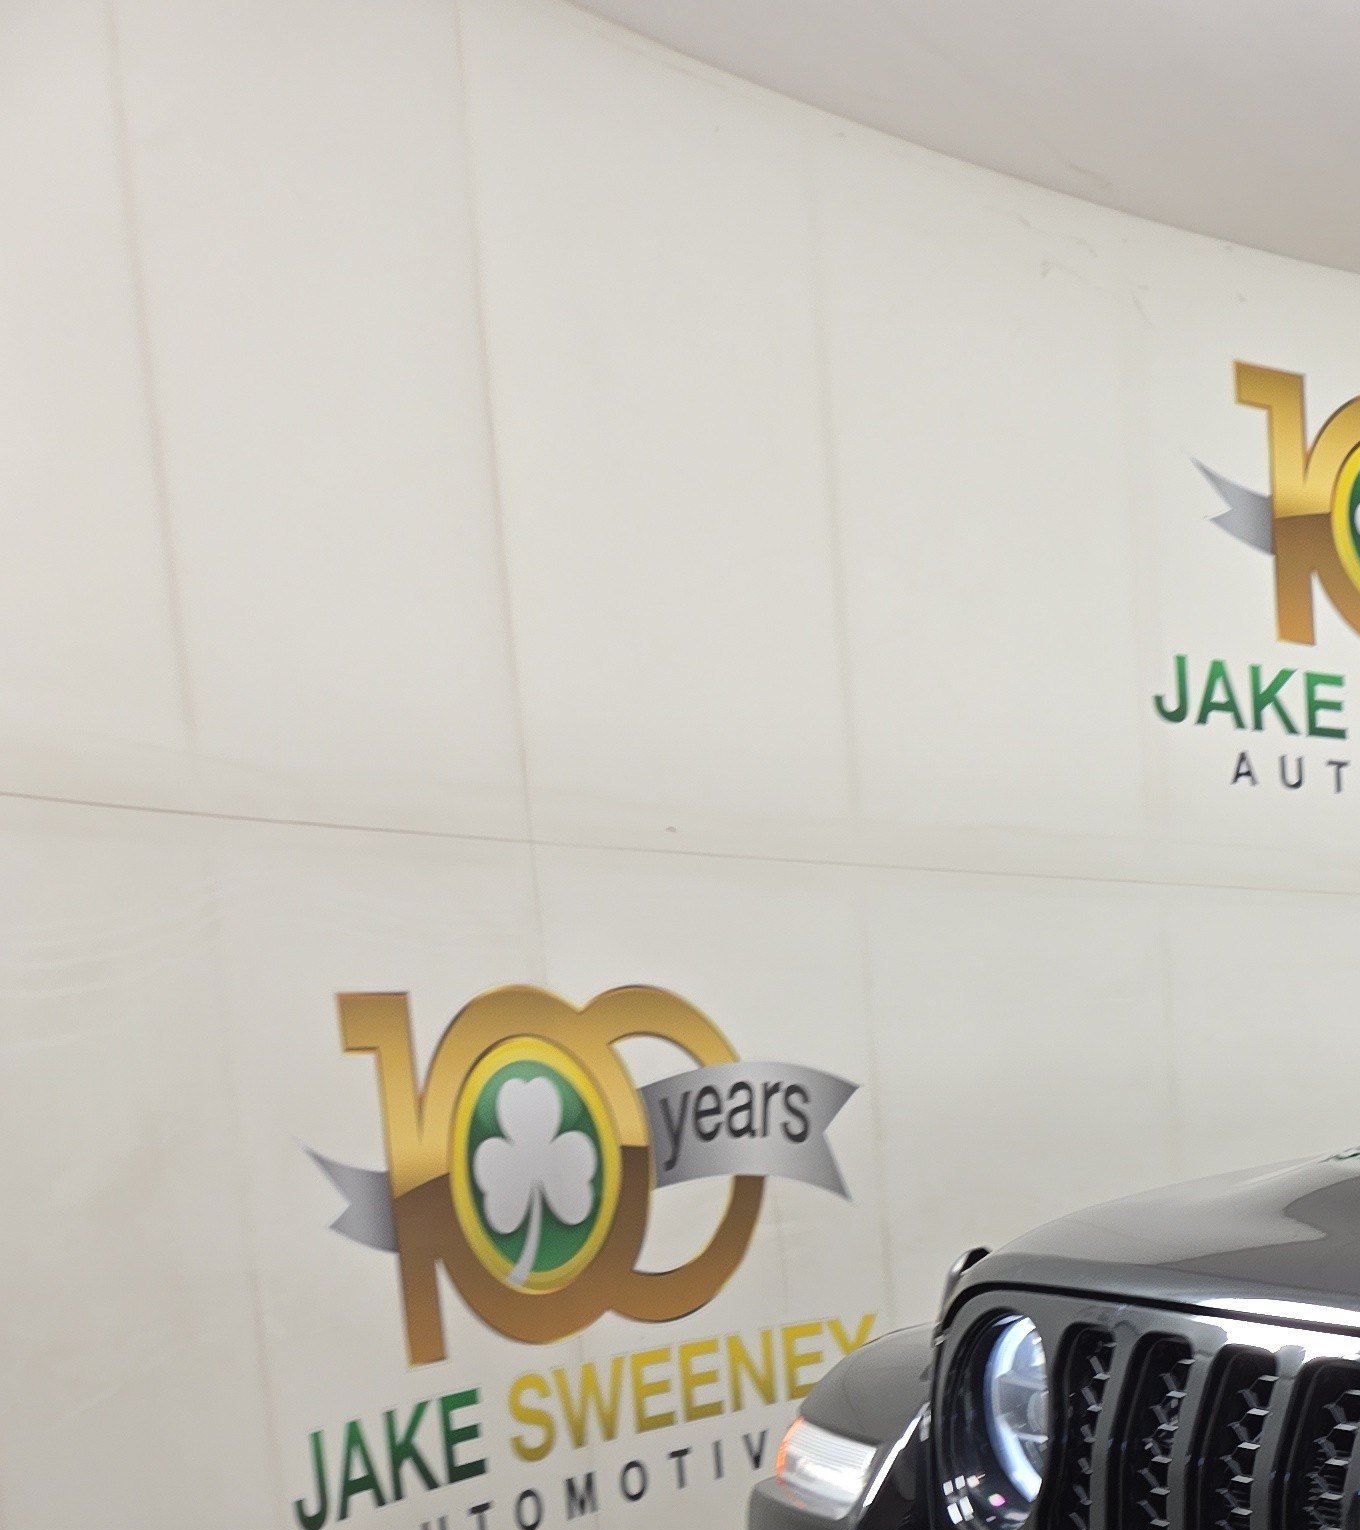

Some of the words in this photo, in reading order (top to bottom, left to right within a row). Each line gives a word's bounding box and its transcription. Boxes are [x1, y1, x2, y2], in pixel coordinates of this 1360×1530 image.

[1152, 653, 1349, 741] JAKE
[335, 983, 766, 1367] 100
[659, 1078, 813, 1173] years
